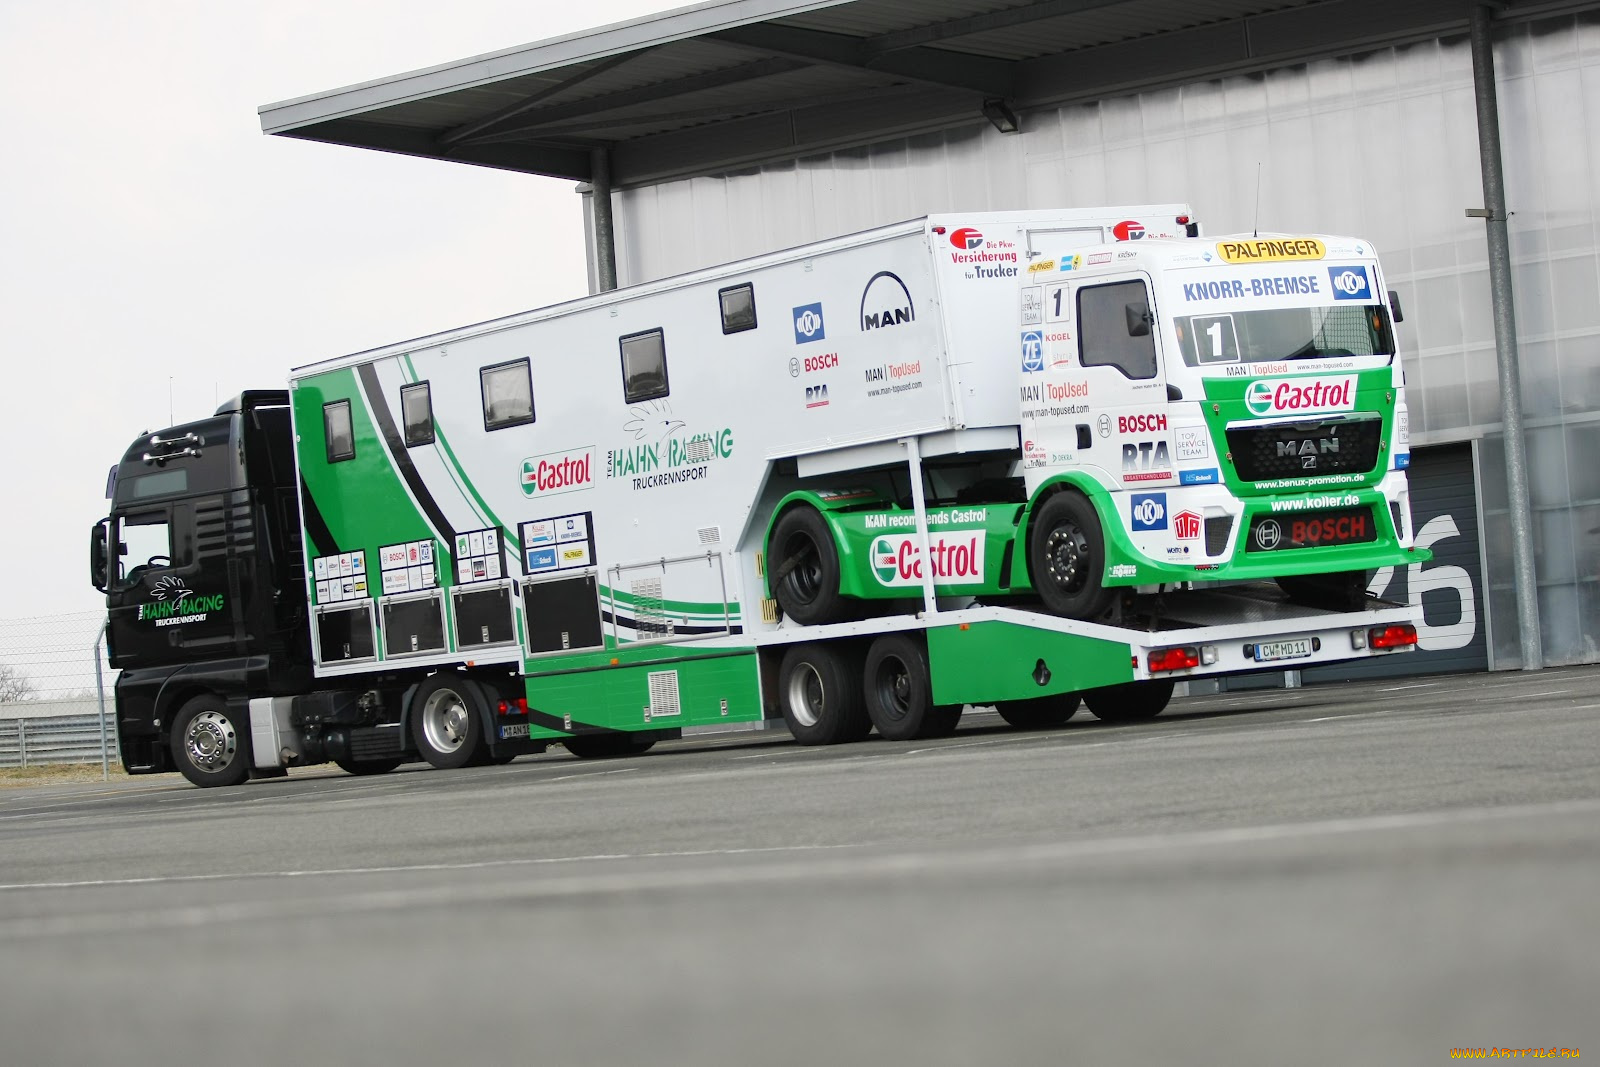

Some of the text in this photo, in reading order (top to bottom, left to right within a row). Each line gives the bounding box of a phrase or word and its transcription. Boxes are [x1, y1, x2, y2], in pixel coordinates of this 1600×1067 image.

[999, 240, 1015, 249] Pkw-
[1223, 241, 1319, 260] PALFINGER
[951, 251, 1017, 264] Versicherung
[965, 266, 1018, 280] für Trucker
[1183, 276, 1320, 302] KNORR-BREMSE
[1053, 289, 1062, 317] 1
[865, 307, 910, 331] MAN
[1207, 322, 1222, 356] 1
[805, 353, 839, 372] BOSCH
[866, 360, 920, 382] MAN TopUsed
[1226, 366, 1246, 376] MAN
[1253, 364, 1288, 375] TopUsed
[806, 384, 829, 401] RTA
[868, 381, 922, 397] www.man-topused.com
[1020, 380, 1088, 402] MAN TopUsed
[1274, 380, 1350, 410] Castrol
[1118, 414, 1168, 433] BOSCH
[1178, 440, 1205, 448] SERVICE
[1182, 448, 1202, 456] TEAM
[1276, 437, 1340, 457] MAN
[613, 442, 659, 478] HAHN
[1122, 441, 1171, 472] RTA
[537, 453, 591, 491] Castrol
[633, 466, 708, 490] TRUCKRENNSPORT
[1254, 473, 1365, 490] www.benux-promotion.de
[1271, 494, 1360, 511] www.koller.de
[865, 508, 987, 528] MAN recomends Castrol
[1291, 515, 1365, 542] BOSCH
[143, 594, 224, 620] HAHN RACING
[155, 613, 207, 627] TRUCKRENNSPORT
[1263, 643, 1307, 657] CW MD 11
